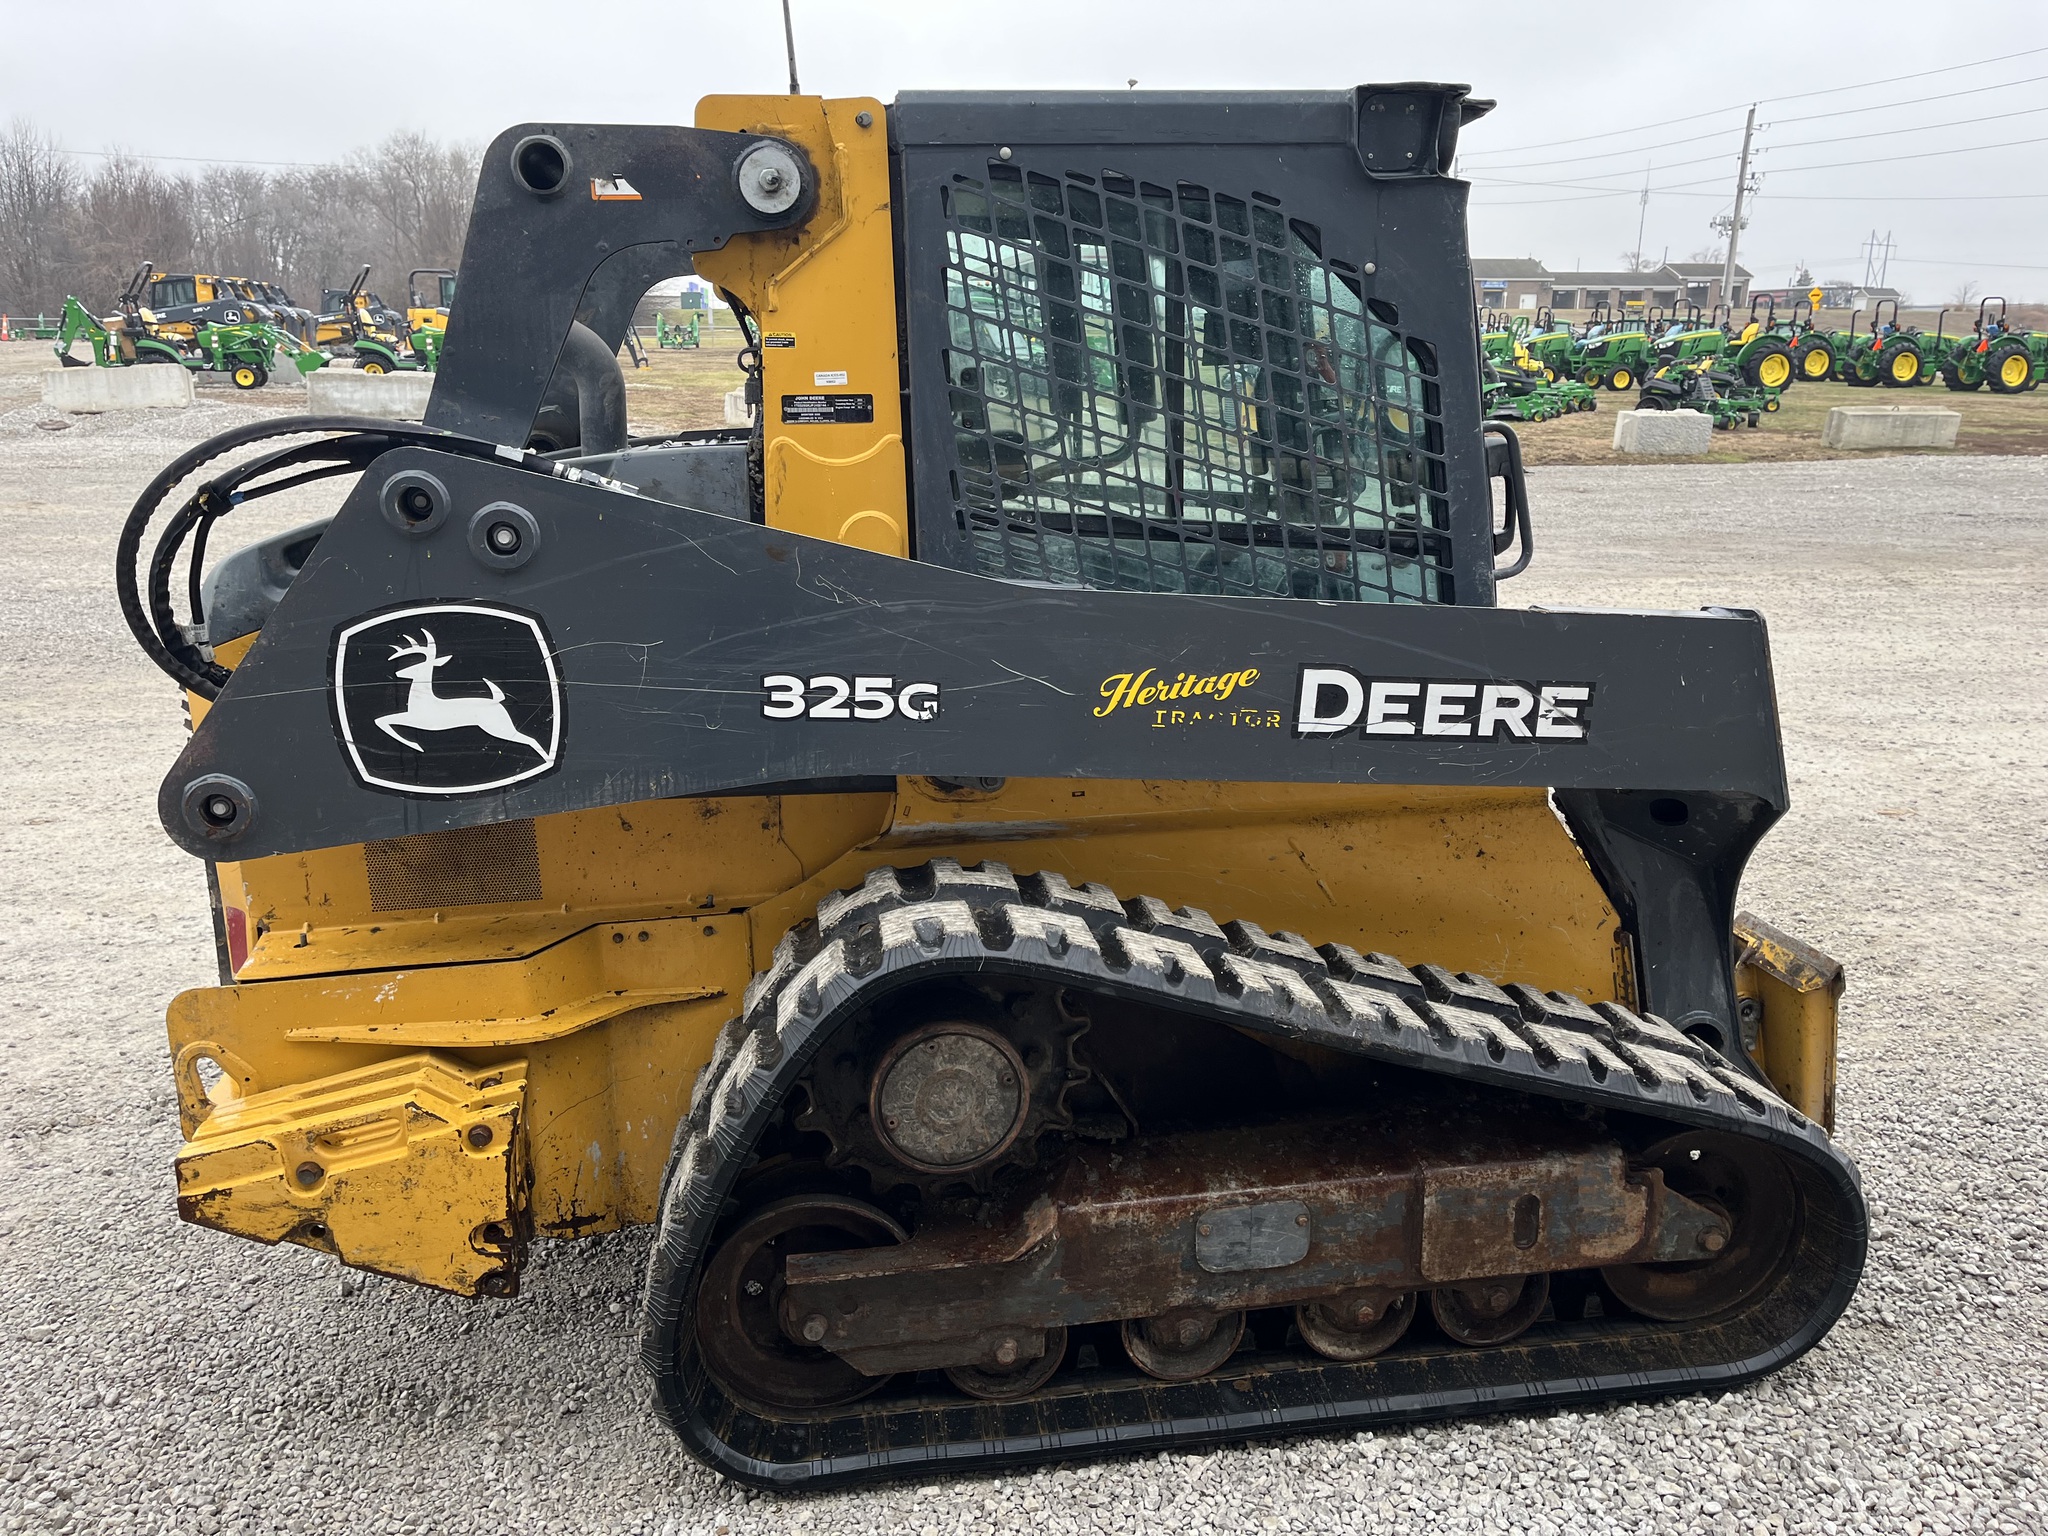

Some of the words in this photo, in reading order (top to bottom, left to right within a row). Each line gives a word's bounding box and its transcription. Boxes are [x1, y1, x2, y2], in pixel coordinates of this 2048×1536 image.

[762, 674, 938, 721] 325G
[1092, 667, 1261, 718] Heritage
[1297, 668, 1590, 738] DEERE
